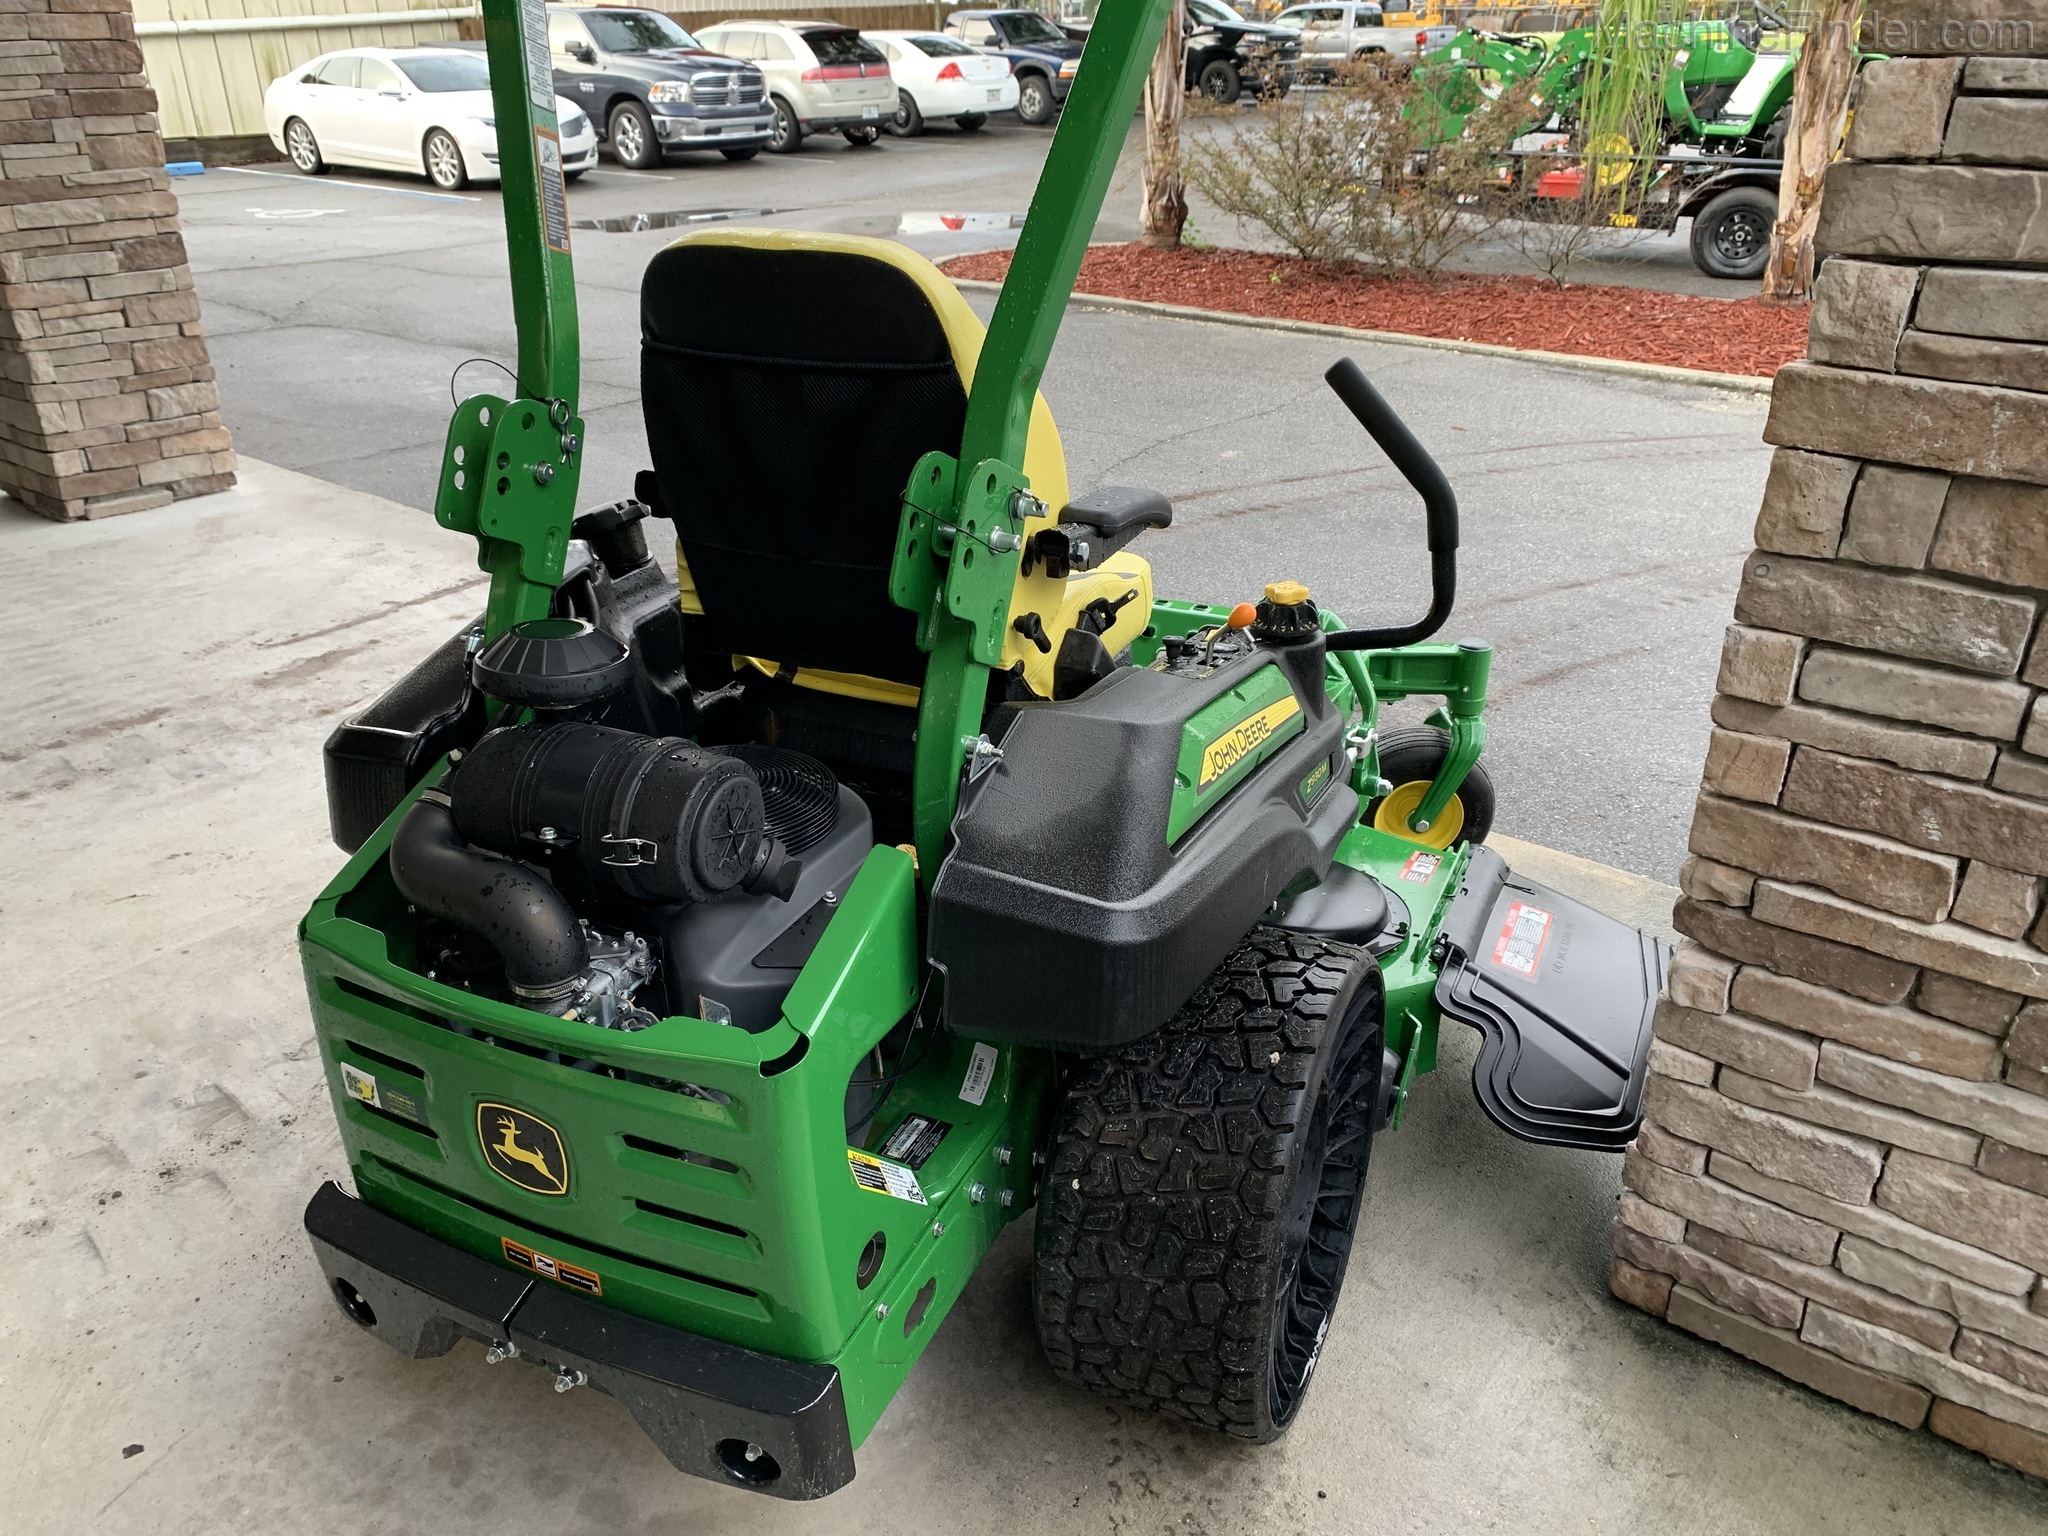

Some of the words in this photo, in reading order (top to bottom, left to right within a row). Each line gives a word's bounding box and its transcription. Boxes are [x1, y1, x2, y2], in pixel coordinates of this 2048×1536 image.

[1208, 738, 1239, 777] JOHN
[1235, 715, 1271, 752] DEERE
[1306, 761, 1327, 794] Z930M
